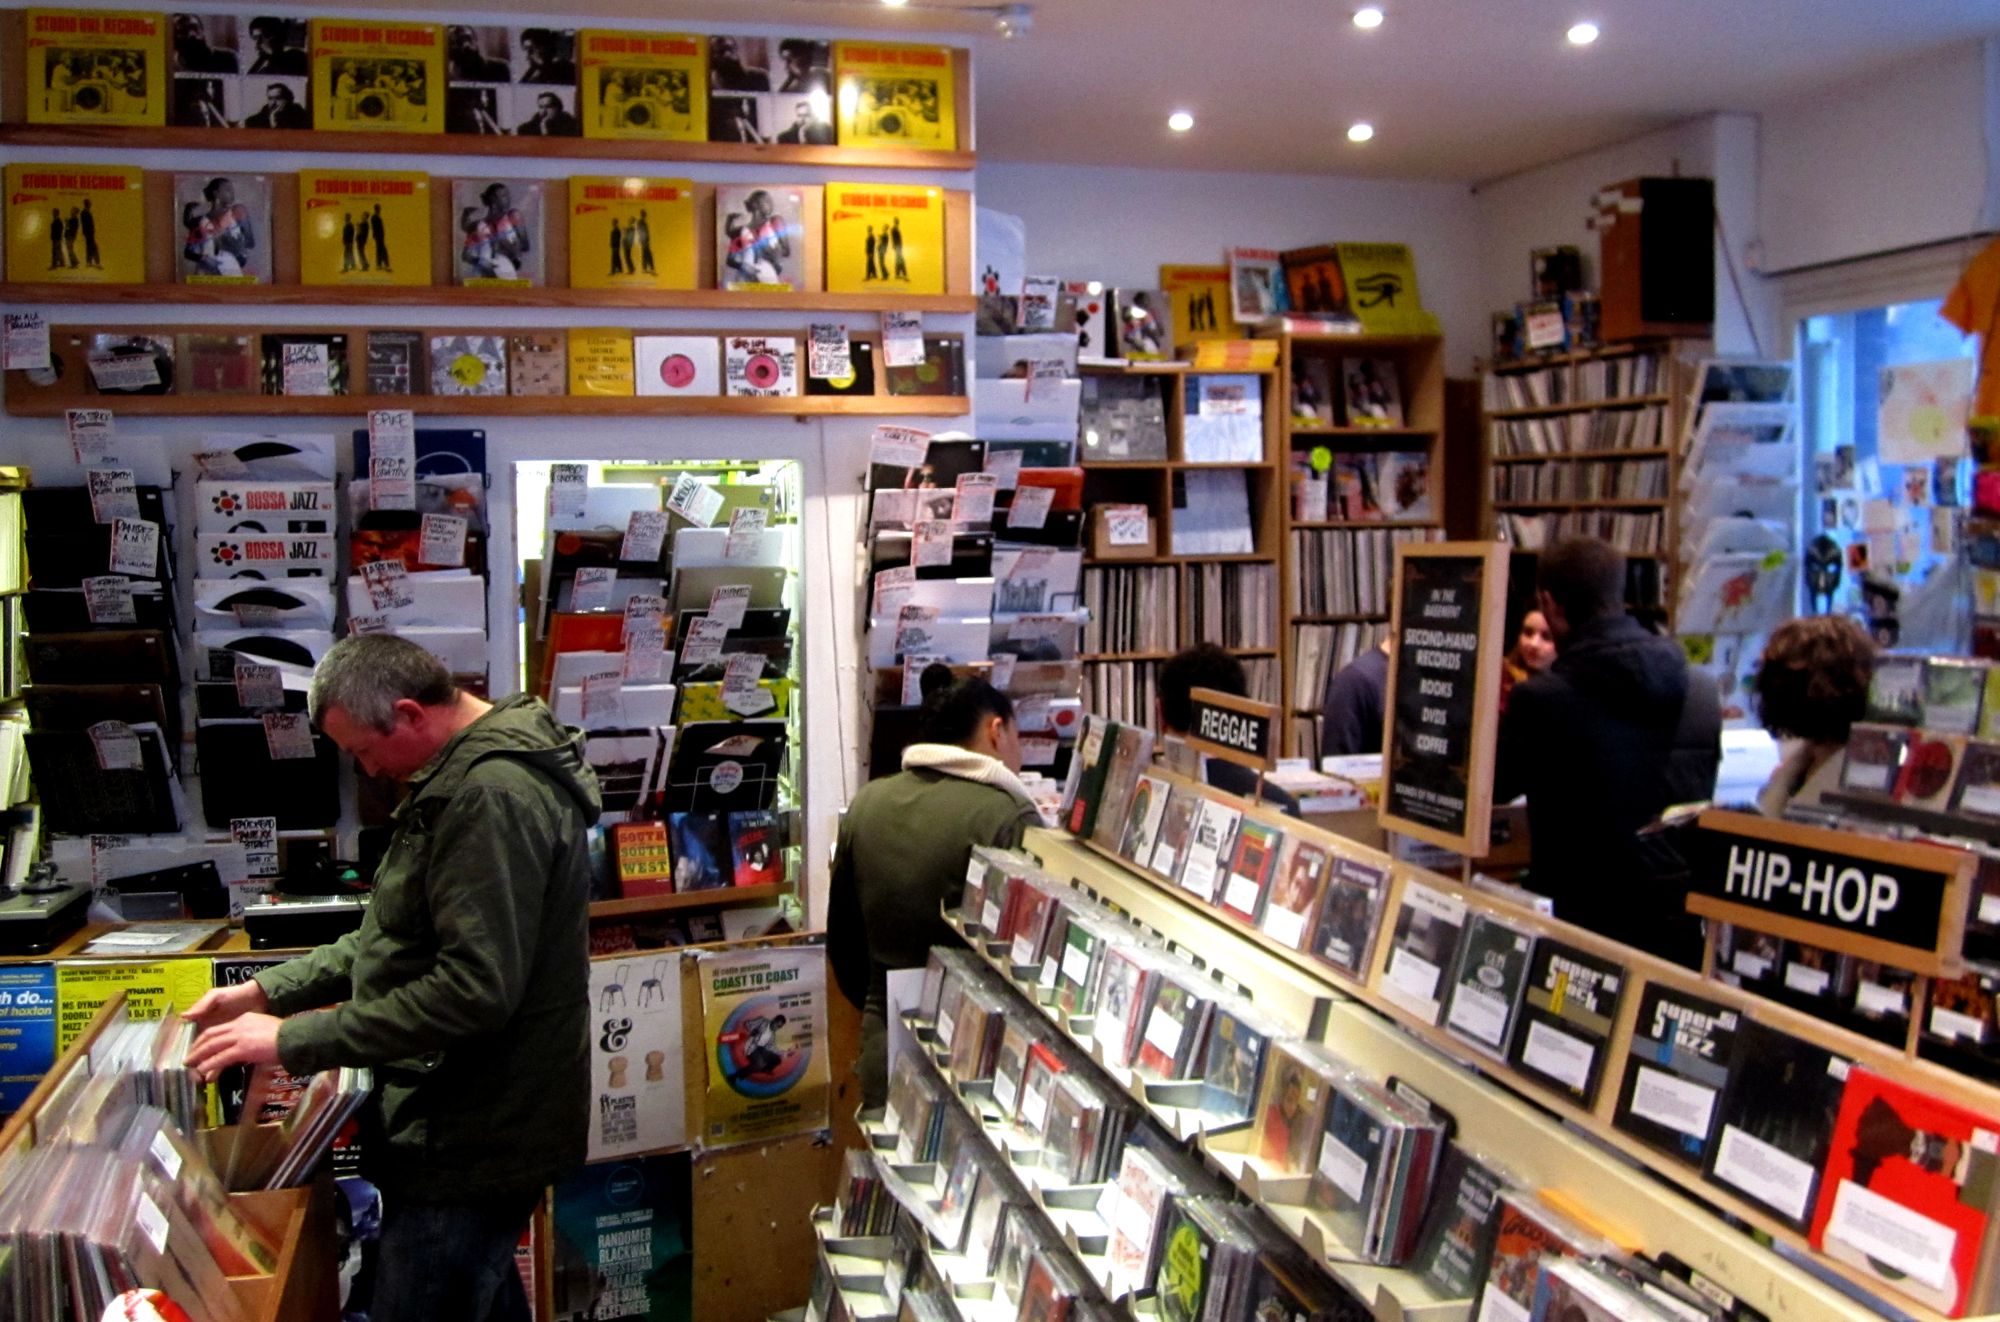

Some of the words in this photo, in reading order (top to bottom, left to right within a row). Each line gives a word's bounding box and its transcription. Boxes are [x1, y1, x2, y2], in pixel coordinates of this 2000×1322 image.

[36, 15, 77, 33] STUDIO
[80, 17, 100, 34] ONE
[104, 17, 156, 36] RECORDS
[321, 26, 360, 42] STUDIO
[363, 28, 382, 43] ONE
[385, 29, 436, 46] RECORDS
[22, 173, 58, 189] STUDIO
[59, 174, 78, 190] ONE
[80, 175, 125, 191] RECORDS
[315, 179, 350, 194] STUDIO
[351, 180, 369, 194] ONE
[370, 181, 413, 195] RECORDS
[245, 491, 287, 510] BOSSA
[290, 491, 319, 510] JAZZ
[245, 540, 285, 560] BOSSA
[288, 540, 318, 560] JAZZ
[1405, 628, 1477, 650] SECOND-HAND
[1416, 649, 1461, 670] RECORDS
[1420, 678, 1453, 698] BOOKS
[1422, 707, 1447, 725] DVDS
[1200, 708, 1259, 751] REGGAE
[1416, 734, 1449, 755] COFFEE
[619, 830, 667, 843] SOUTH
[620, 845, 667, 858] SOUTH
[622, 861, 667, 875] WEST
[1725, 845, 1899, 927] HIP-HOP
[713, 975, 747, 990] COAST
[750, 973, 763, 985] TO
[766, 968, 799, 983] COAST
[1546, 954, 1603, 990] Super
[17, 990, 54, 1004] do...
[62, 1001, 74, 1010] MS
[144, 999, 154, 1007] FX
[11, 1006, 52, 1016] hoxton
[62, 1011, 93, 1020] DOORLY
[134, 1009, 145, 1018] DJ
[147, 1009, 161, 1018] SET
[1651, 1000, 1721, 1039] Super
[1656, 1017, 1716, 1066] Jazz
[598, 1227, 652, 1249] RANDOMER
[599, 1242, 651, 1264] BLACKWAX
[597, 1298, 651, 1321] ELSEWHERE
